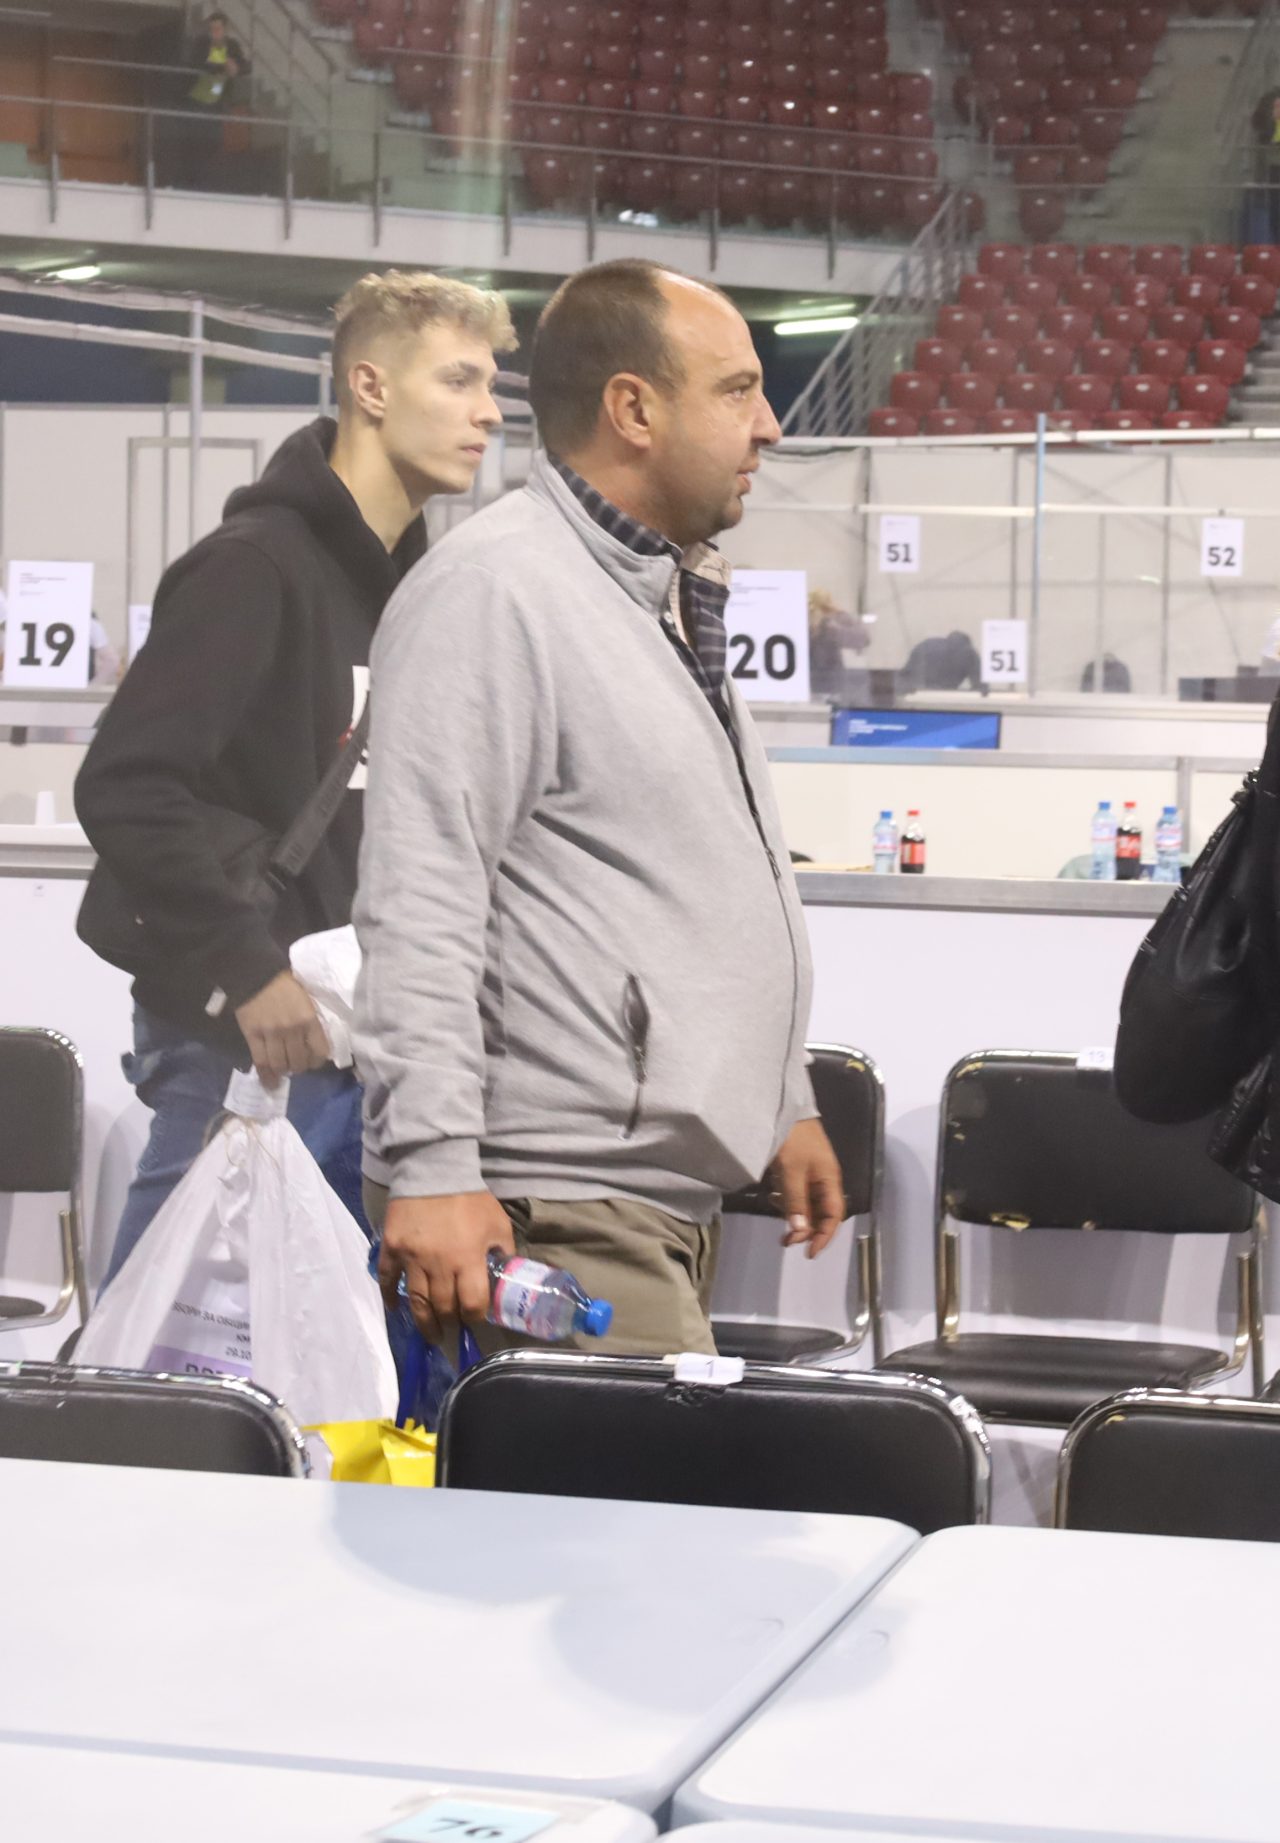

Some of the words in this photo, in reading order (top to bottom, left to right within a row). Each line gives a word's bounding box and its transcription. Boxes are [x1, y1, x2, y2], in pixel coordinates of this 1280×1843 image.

[887, 543, 912, 563] 51
[1208, 546, 1236, 567] 52
[19, 622, 75, 667] 19
[729, 634, 796, 680] 20
[991, 650, 1019, 672] 51
